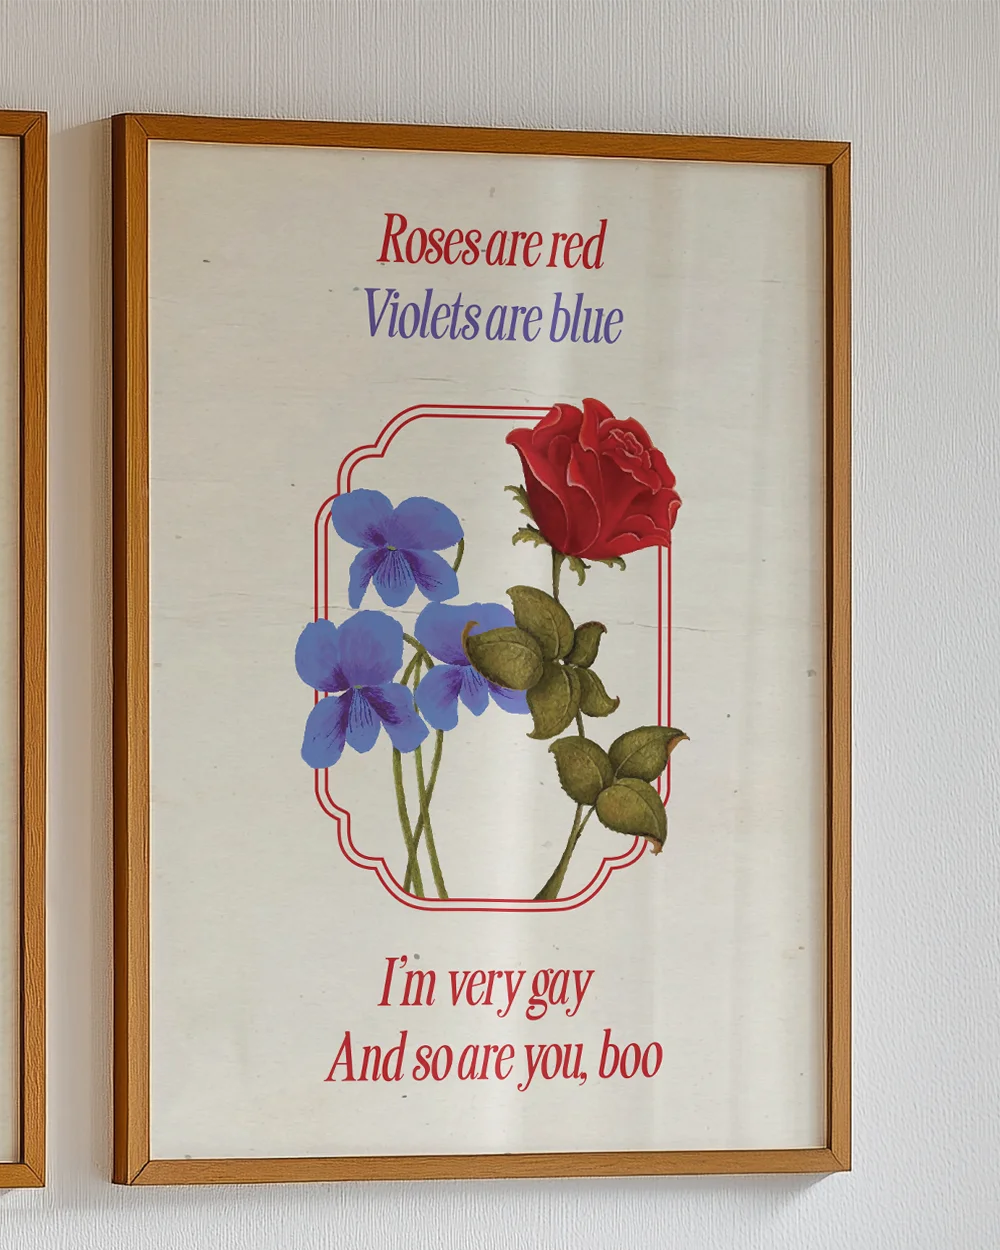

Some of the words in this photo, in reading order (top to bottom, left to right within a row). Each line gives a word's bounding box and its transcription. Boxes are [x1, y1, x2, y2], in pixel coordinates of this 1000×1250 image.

[376, 212, 482, 265] Roses
[485, 229, 543, 267] are
[546, 218, 608, 270] red
[364, 287, 482, 341] Violets
[485, 303, 543, 342] are
[549, 291, 624, 344] blue
[377, 955, 437, 1007] I'm
[447, 969, 526, 1018] very
[525, 968, 595, 1021] gay
[324, 1029, 409, 1082] And
[411, 1042, 453, 1081] so
[457, 1041, 515, 1081] are
[517, 1041, 588, 1092] you,
[598, 1028, 664, 1080] boo
